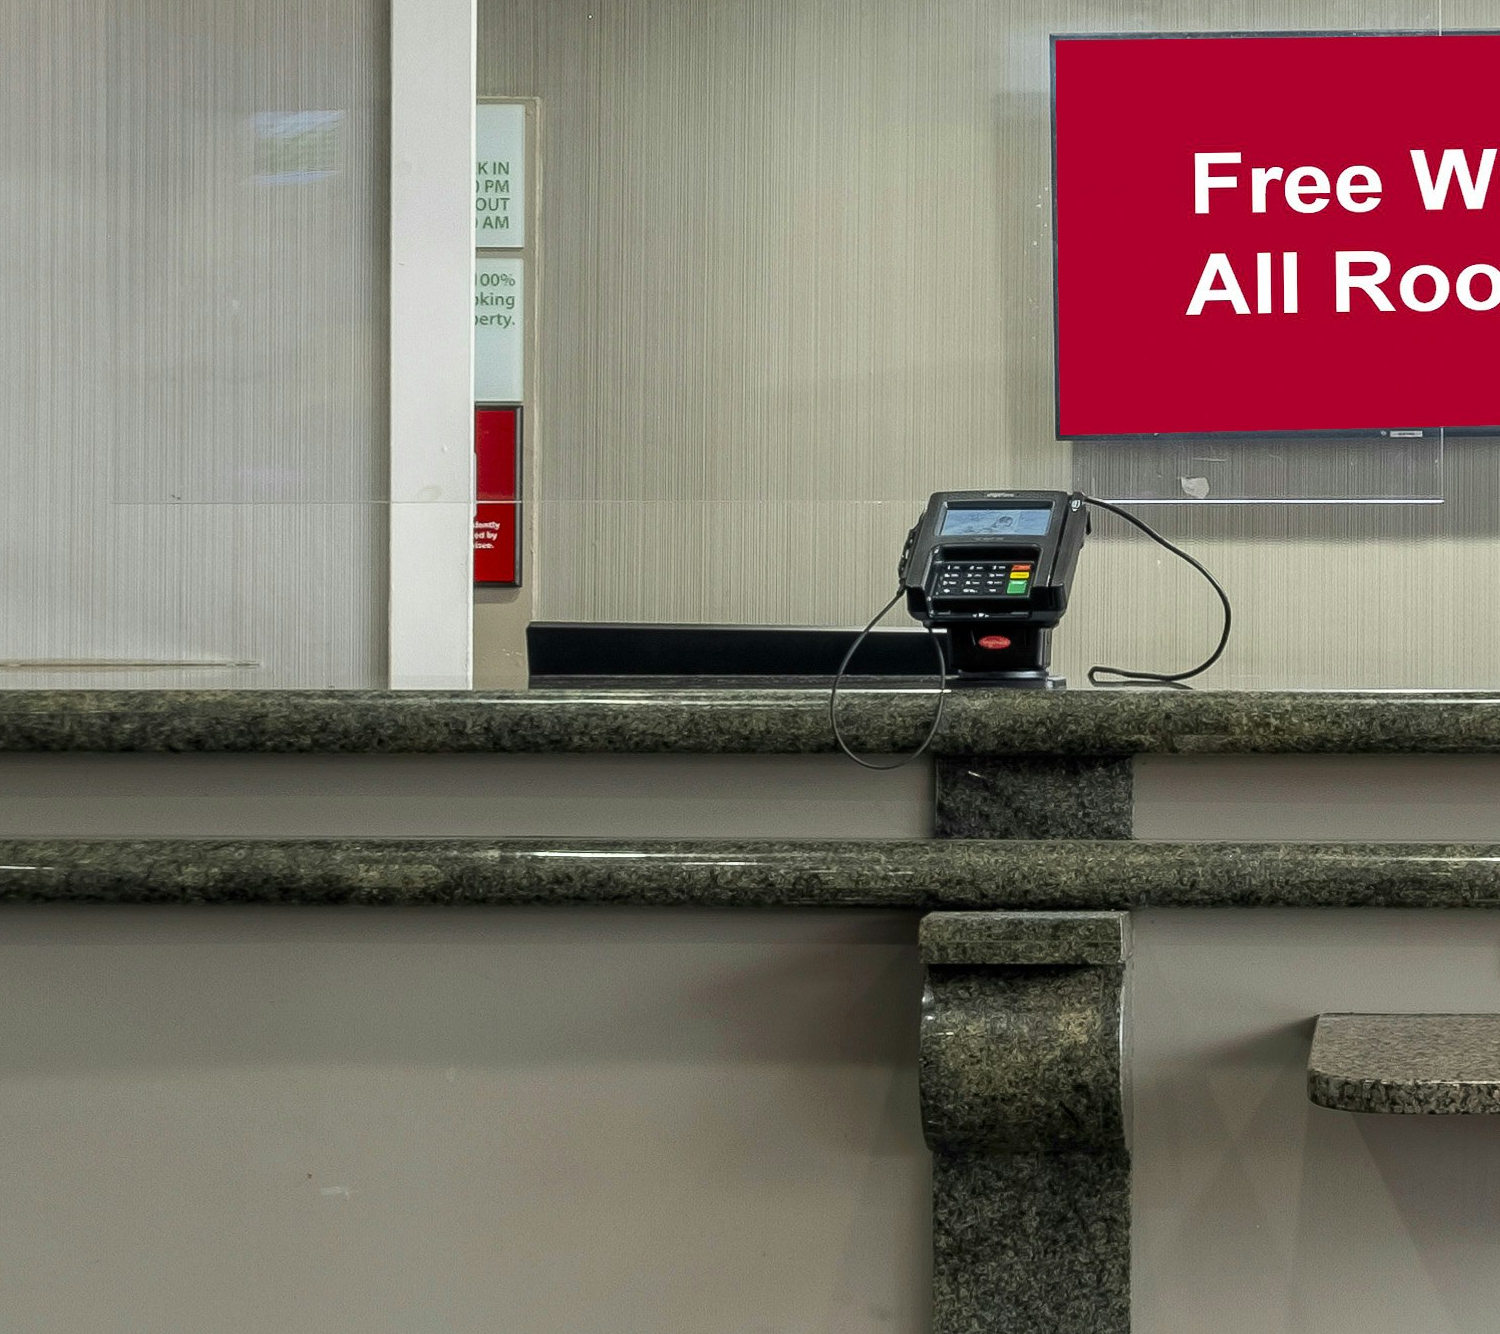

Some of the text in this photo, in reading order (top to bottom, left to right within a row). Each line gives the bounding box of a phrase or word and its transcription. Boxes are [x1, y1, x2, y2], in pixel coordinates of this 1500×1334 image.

[493, 161, 509, 175] IN
[485, 179, 510, 193] PM
[1194, 152, 1383, 214] Free
[475, 197, 510, 212] OUT
[483, 216, 509, 229] AM
[1186, 252, 1298, 316] All
